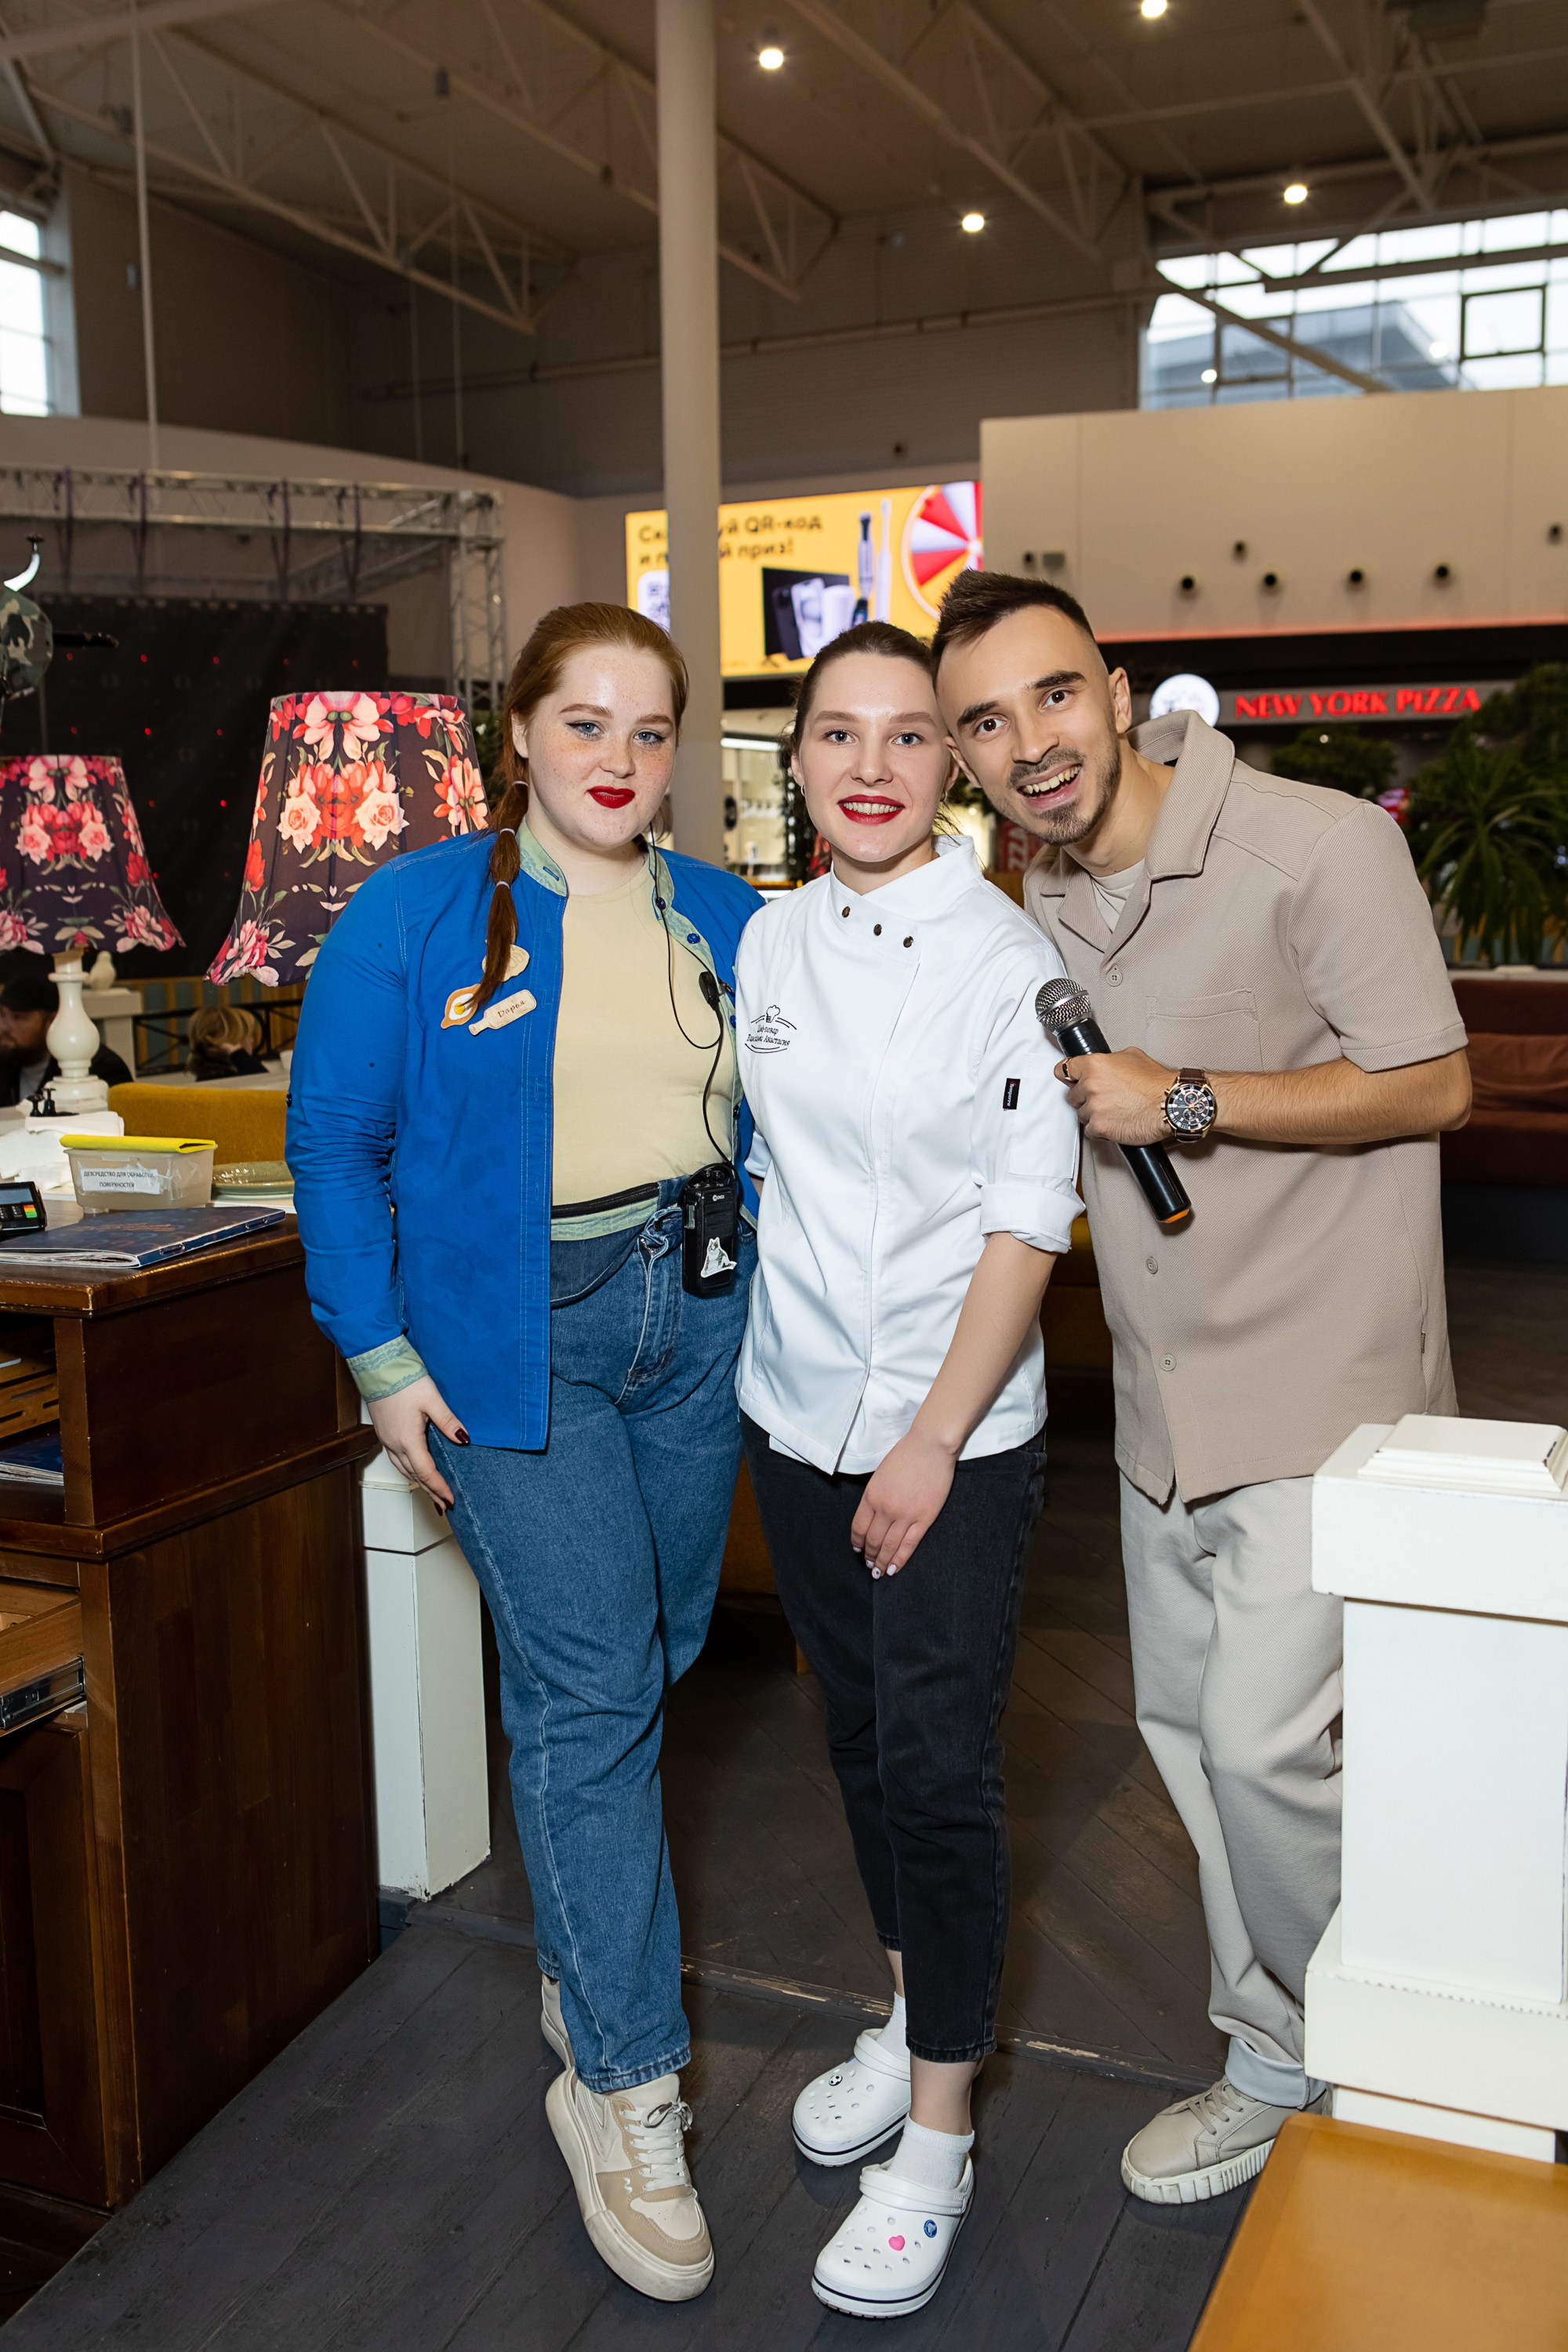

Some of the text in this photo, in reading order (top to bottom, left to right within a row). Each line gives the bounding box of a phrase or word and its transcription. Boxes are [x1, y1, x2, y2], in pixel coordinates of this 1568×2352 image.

[1236, 694, 1301, 718] NEW
[1309, 691, 1389, 716] YORK
[1396, 688, 1481, 713] PIZZA
